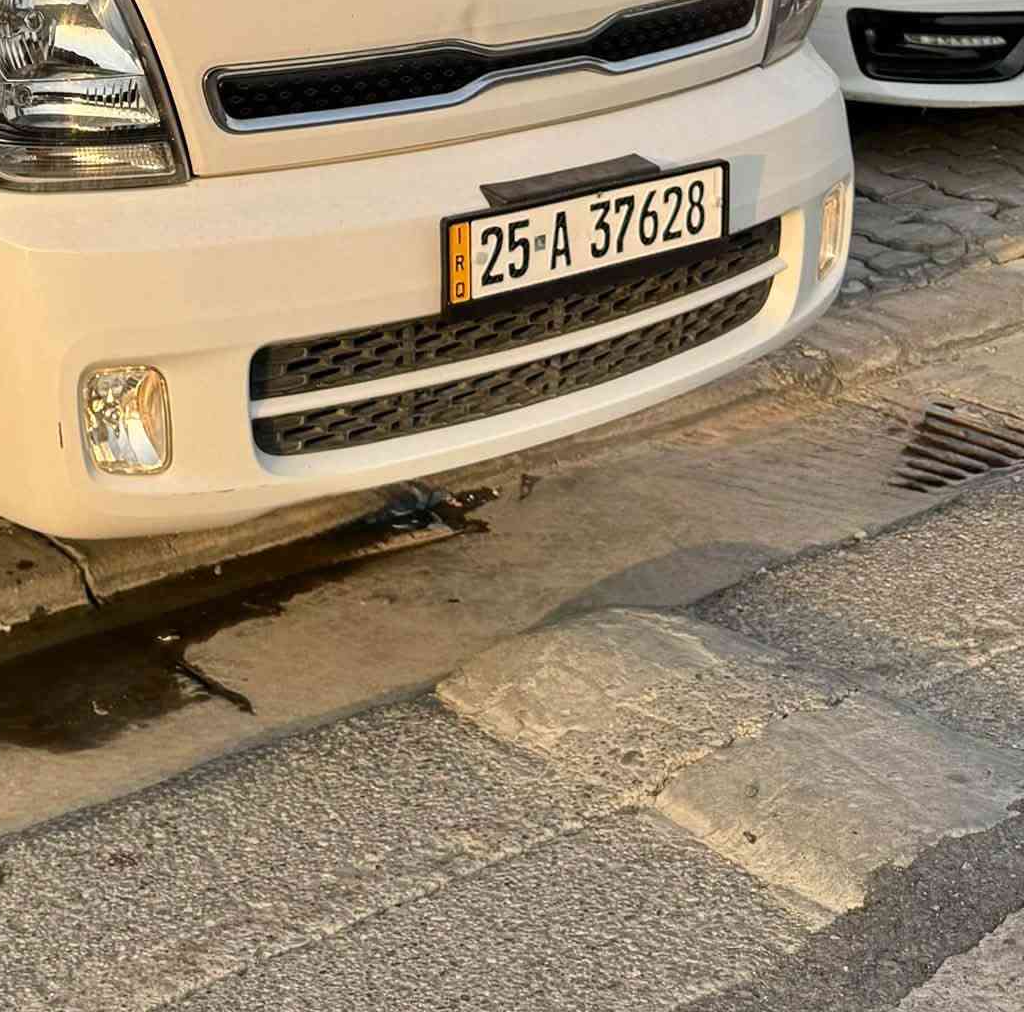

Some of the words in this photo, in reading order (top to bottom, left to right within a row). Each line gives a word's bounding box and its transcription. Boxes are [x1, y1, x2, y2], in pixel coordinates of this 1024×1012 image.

[480, 218, 530, 286] 25
[551, 211, 571, 270] A
[590, 180, 705, 259] 37628
